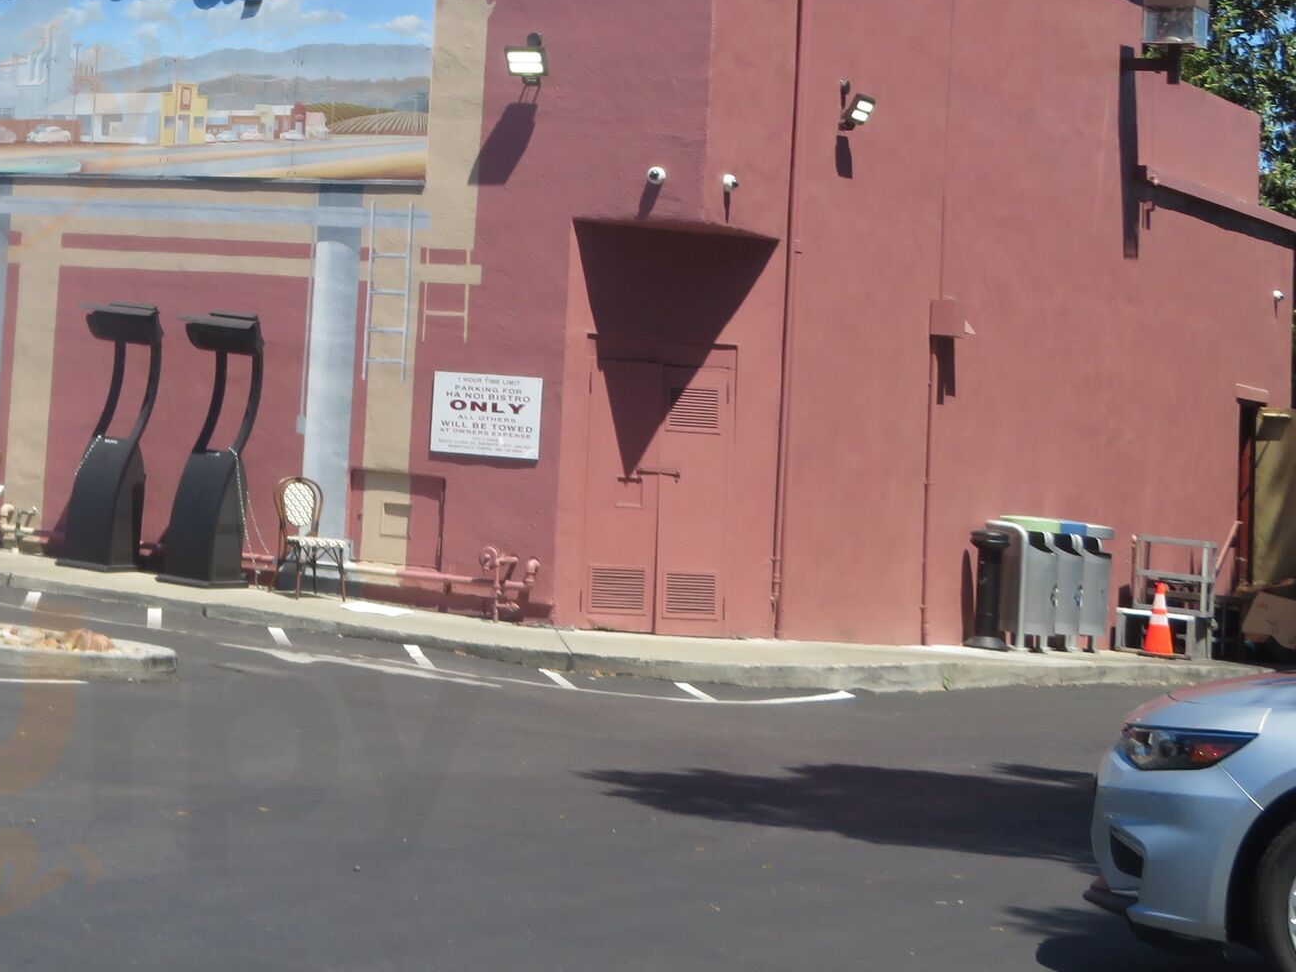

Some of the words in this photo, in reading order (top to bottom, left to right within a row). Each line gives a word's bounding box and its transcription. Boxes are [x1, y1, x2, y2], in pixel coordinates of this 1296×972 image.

[454, 385, 499, 393] PARKING
[488, 394, 531, 403] BISTRO
[449, 399, 525, 415] ONLY
[441, 419, 468, 428] WILL
[472, 422, 487, 430] BE
[492, 424, 533, 432] TOWED
[453, 428, 489, 436] OWNERS
